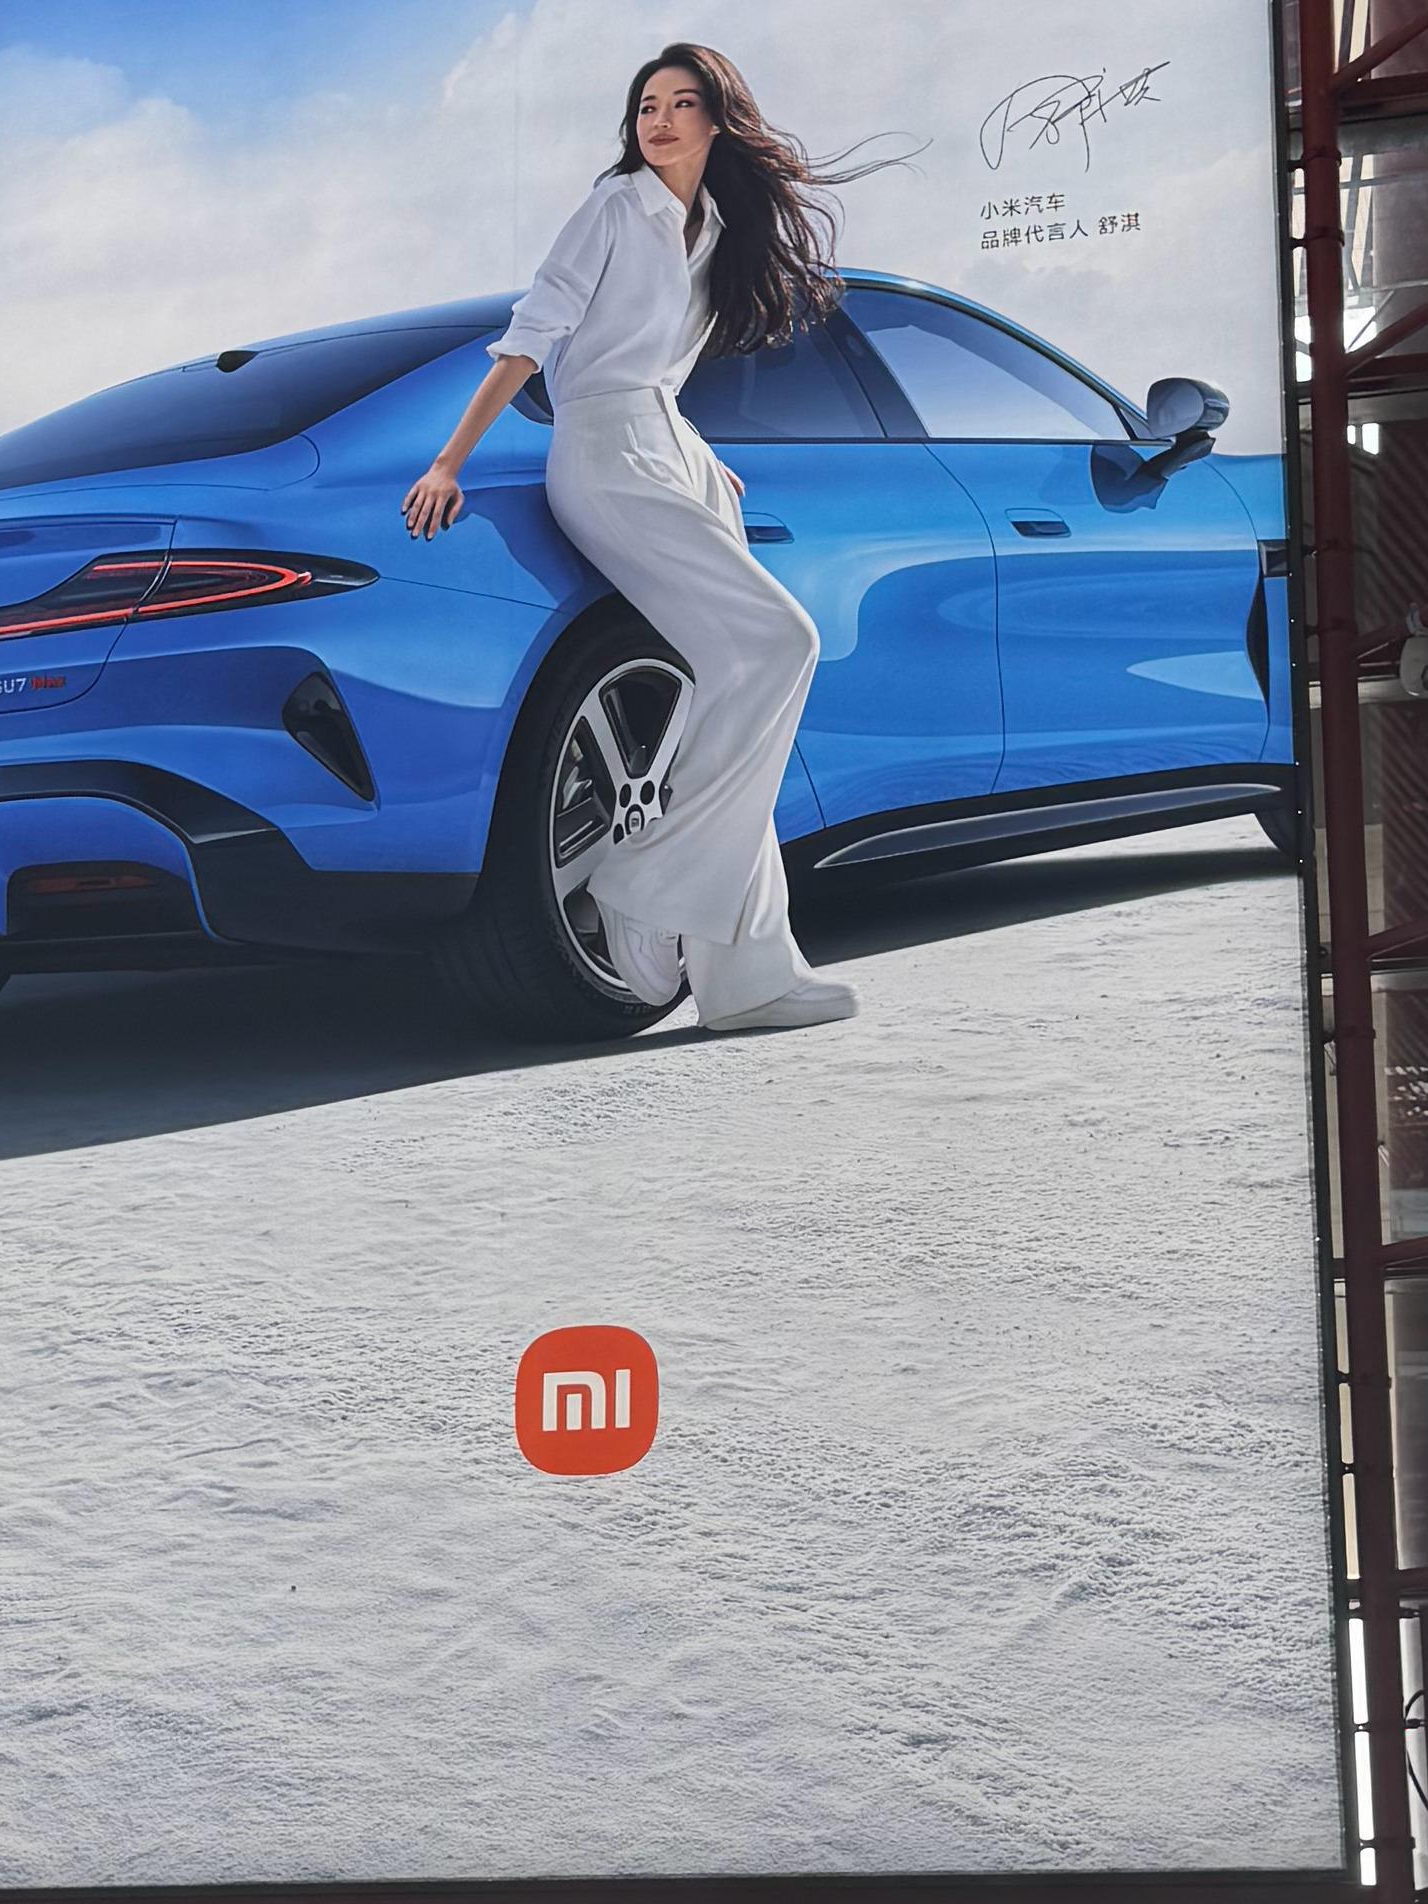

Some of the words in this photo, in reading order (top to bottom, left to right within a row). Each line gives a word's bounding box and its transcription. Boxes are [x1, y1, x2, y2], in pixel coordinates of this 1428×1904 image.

[980, 193, 1065, 220] 小米汽车
[981, 219, 1088, 250] 品牌代言人
[1098, 212, 1141, 235] 舒淇
